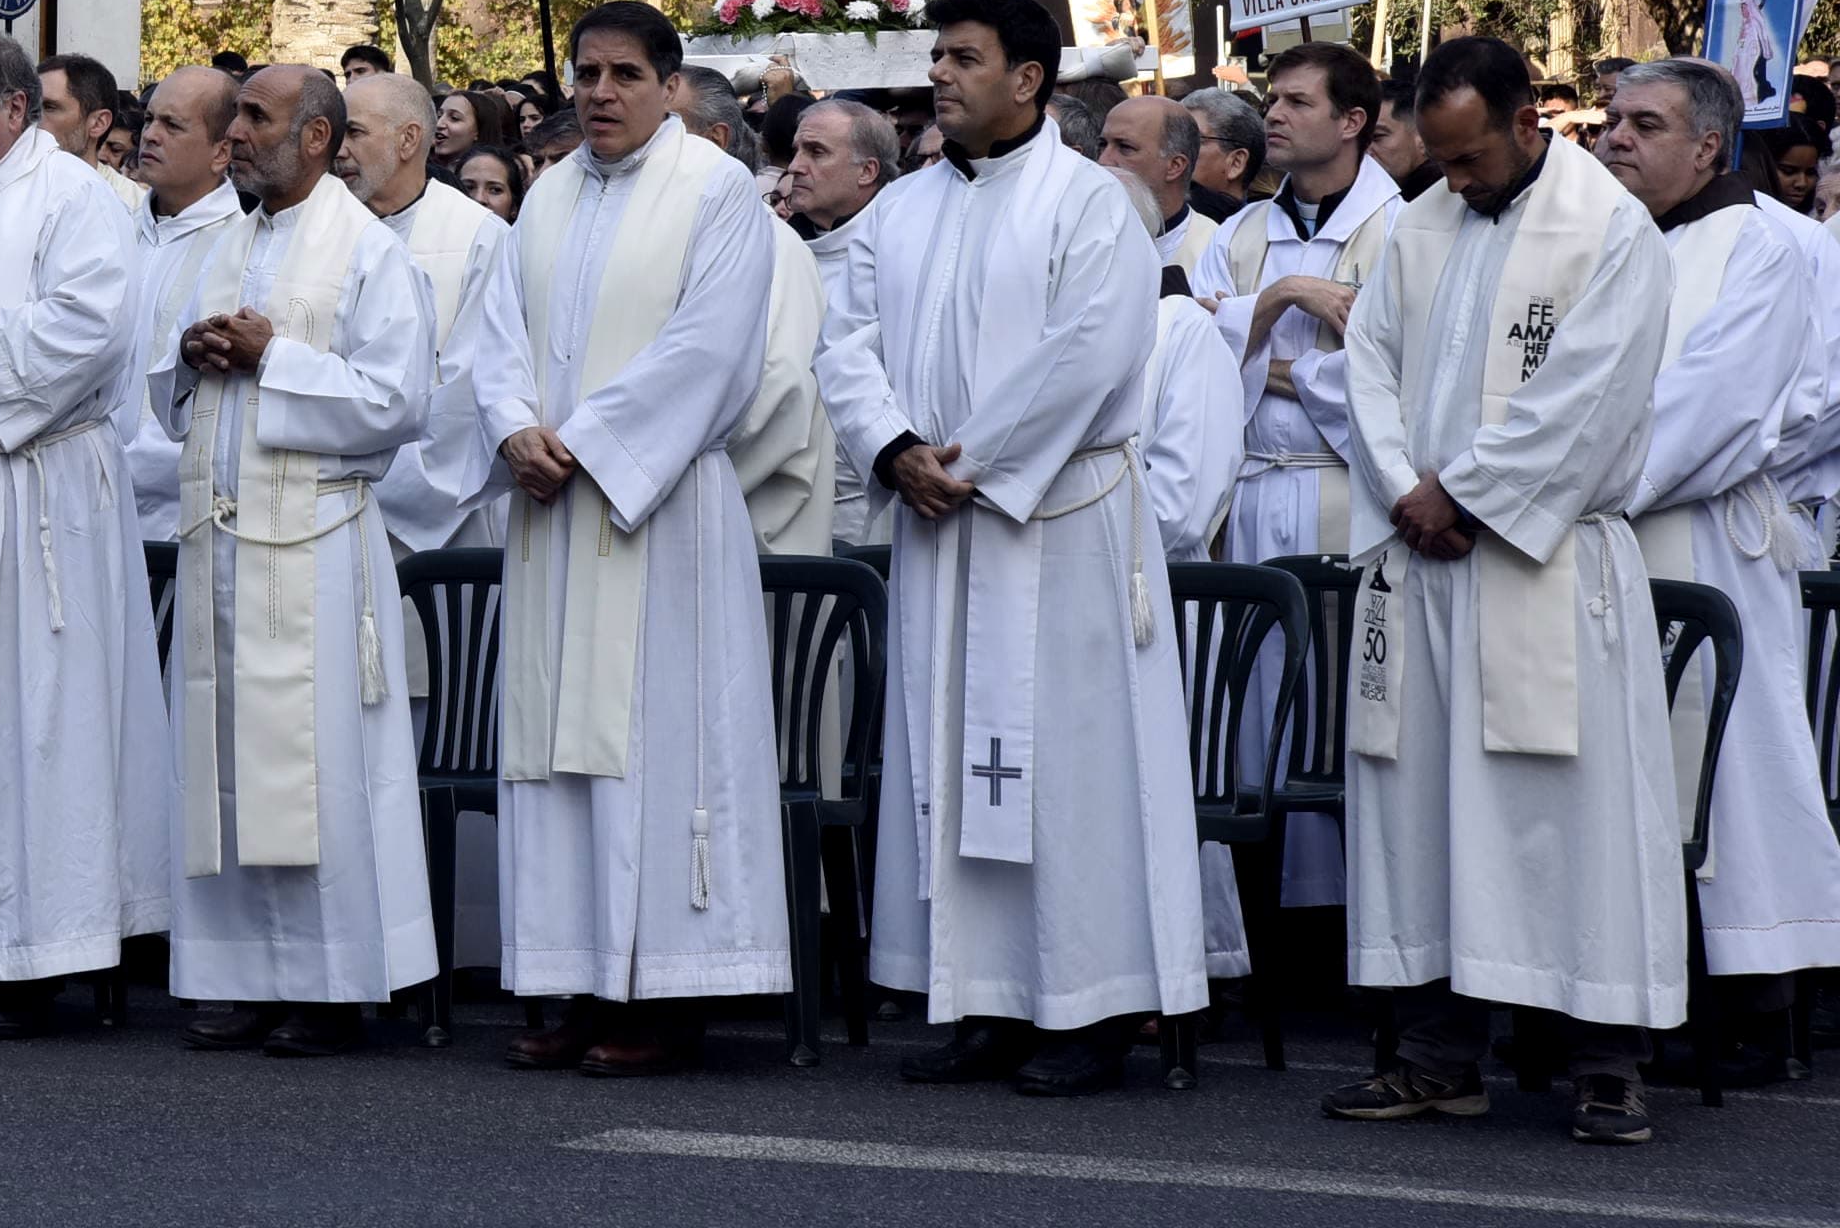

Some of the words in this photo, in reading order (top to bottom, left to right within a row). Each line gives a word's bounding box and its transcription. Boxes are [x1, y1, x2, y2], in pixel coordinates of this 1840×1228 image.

[1527, 303, 1554, 326] FE
[1507, 322, 1556, 342] AMA
[1363, 626, 1387, 665] 50
